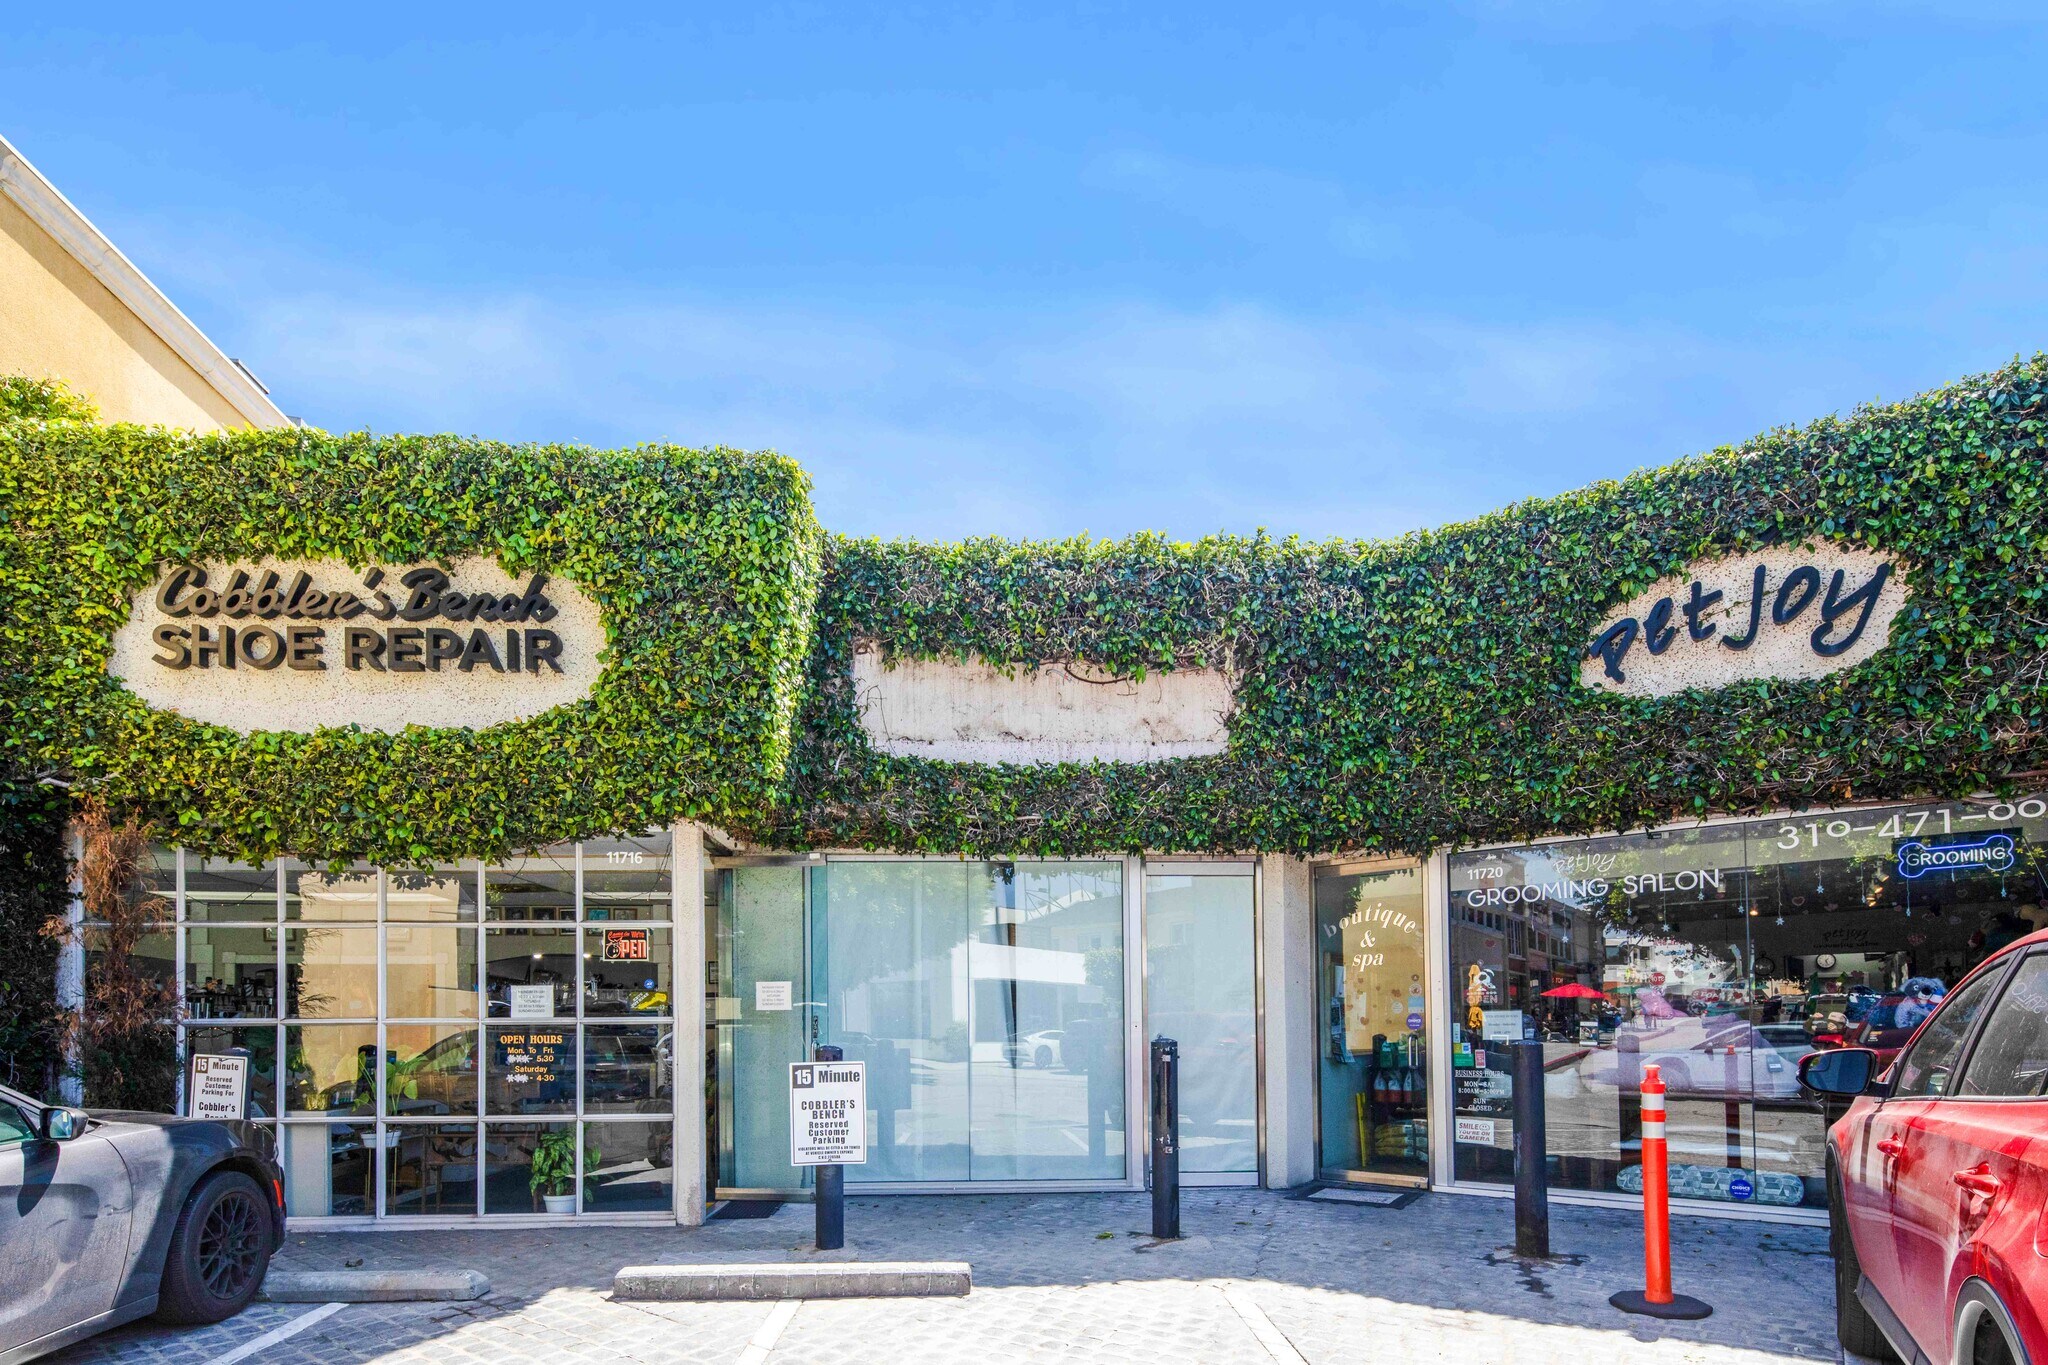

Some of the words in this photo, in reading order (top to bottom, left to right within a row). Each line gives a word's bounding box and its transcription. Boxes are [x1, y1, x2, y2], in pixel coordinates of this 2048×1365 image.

[155, 563, 398, 620] Cobbler's
[399, 567, 559, 623] Bench
[151, 623, 328, 671] SHOE
[344, 626, 565, 673] REPAIR
[606, 851, 643, 864] 11716
[1905, 847, 2006, 867] GROOMING
[1467, 867, 1503, 881] 11720
[1467, 878, 1608, 907] GROOMING
[1622, 869, 1719, 895] SALON
[1323, 902, 1416, 938] boutique
[1360, 929, 1376, 948] &
[1352, 952, 1383, 972] spa
[500, 1035, 525, 1044] OPEN
[530, 1035, 563, 1044] HOURS
[196, 1058, 208, 1071] 15
[212, 1062, 239, 1071] Minute
[795, 1068, 812, 1085] 15
[818, 1070, 860, 1083] Minute
[1484, 1070, 1505, 1078] HOURS
[204, 1082, 232, 1090] Customer
[201, 1089, 223, 1097] Parking
[198, 1101, 236, 1113] Cobbler's
[801, 1099, 856, 1111] COBBLER'S
[812, 1109, 845, 1120] BENCH
[808, 1120, 849, 1129] Reserved
[1458, 1122, 1479, 1130] SMILE
[808, 1129, 850, 1137] Customer
[1458, 1134, 1490, 1142] CAMERA
[812, 1136, 846, 1145] Parking
